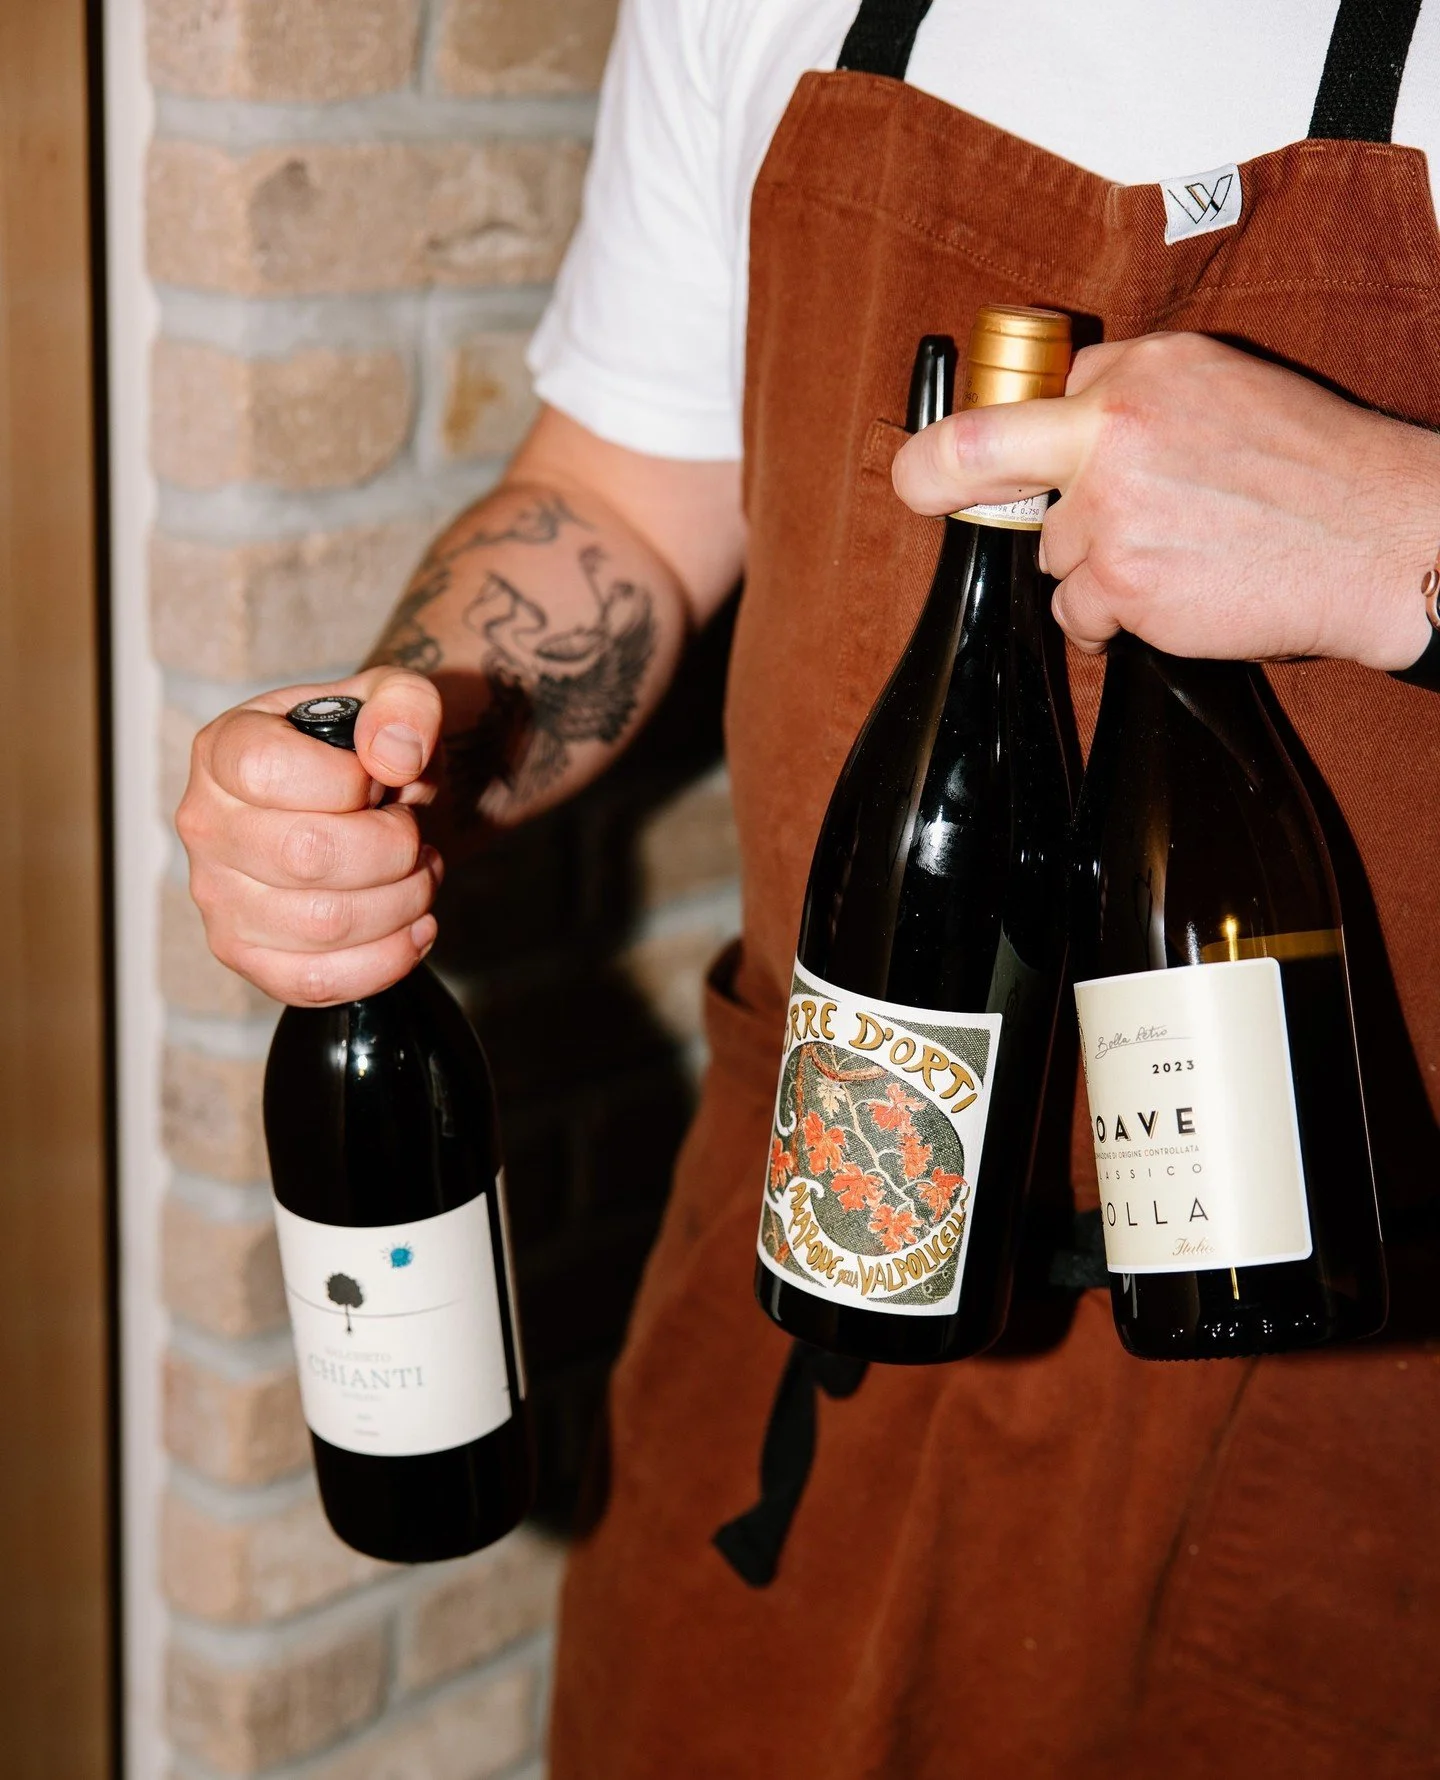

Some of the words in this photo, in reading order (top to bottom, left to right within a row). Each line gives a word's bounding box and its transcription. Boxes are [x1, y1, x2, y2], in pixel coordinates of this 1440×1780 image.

[1020, 507, 1039, 516] 0.750
[849, 1012, 978, 1114] D'ORTI
[1152, 1060, 1194, 1074] 2023
[1094, 1107, 1196, 1143] OAVE
[1144, 1145, 1200, 1157] CONTROLLATA
[1099, 1163, 1202, 1180] LASSICO
[1101, 1197, 1209, 1227] OLLA
[308, 1352, 427, 1389] CHIANTI
